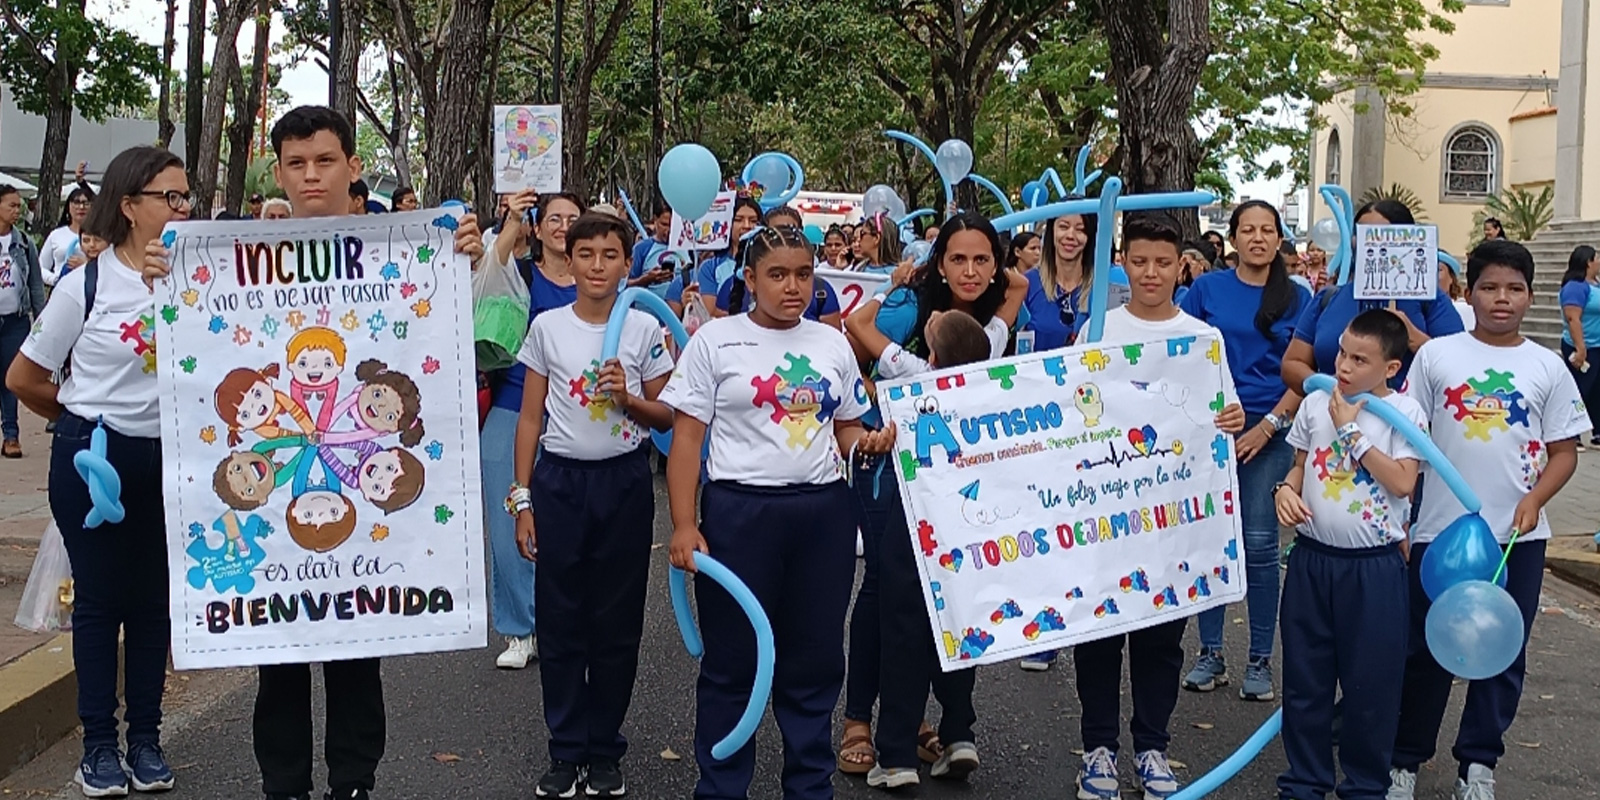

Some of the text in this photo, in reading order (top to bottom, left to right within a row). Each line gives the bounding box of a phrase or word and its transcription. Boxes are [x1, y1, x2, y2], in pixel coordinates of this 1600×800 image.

[1366, 227, 1426, 242] AUTISMO
[213, 293, 239, 312] no
[247, 290, 265, 311] es
[234, 309, 407, 345] AUTISMO
[914, 401, 1063, 468] AUTISMO
[1067, 479, 1097, 508] feliz
[1101, 476, 1130, 500] viaje
[1134, 478, 1154, 497] por
[1156, 464, 1169, 484] la
[965, 492, 1216, 571] TODOS DEJAMOS HUELLA
[297, 555, 342, 582] dar
[206, 584, 454, 634] BIENVENIDA
